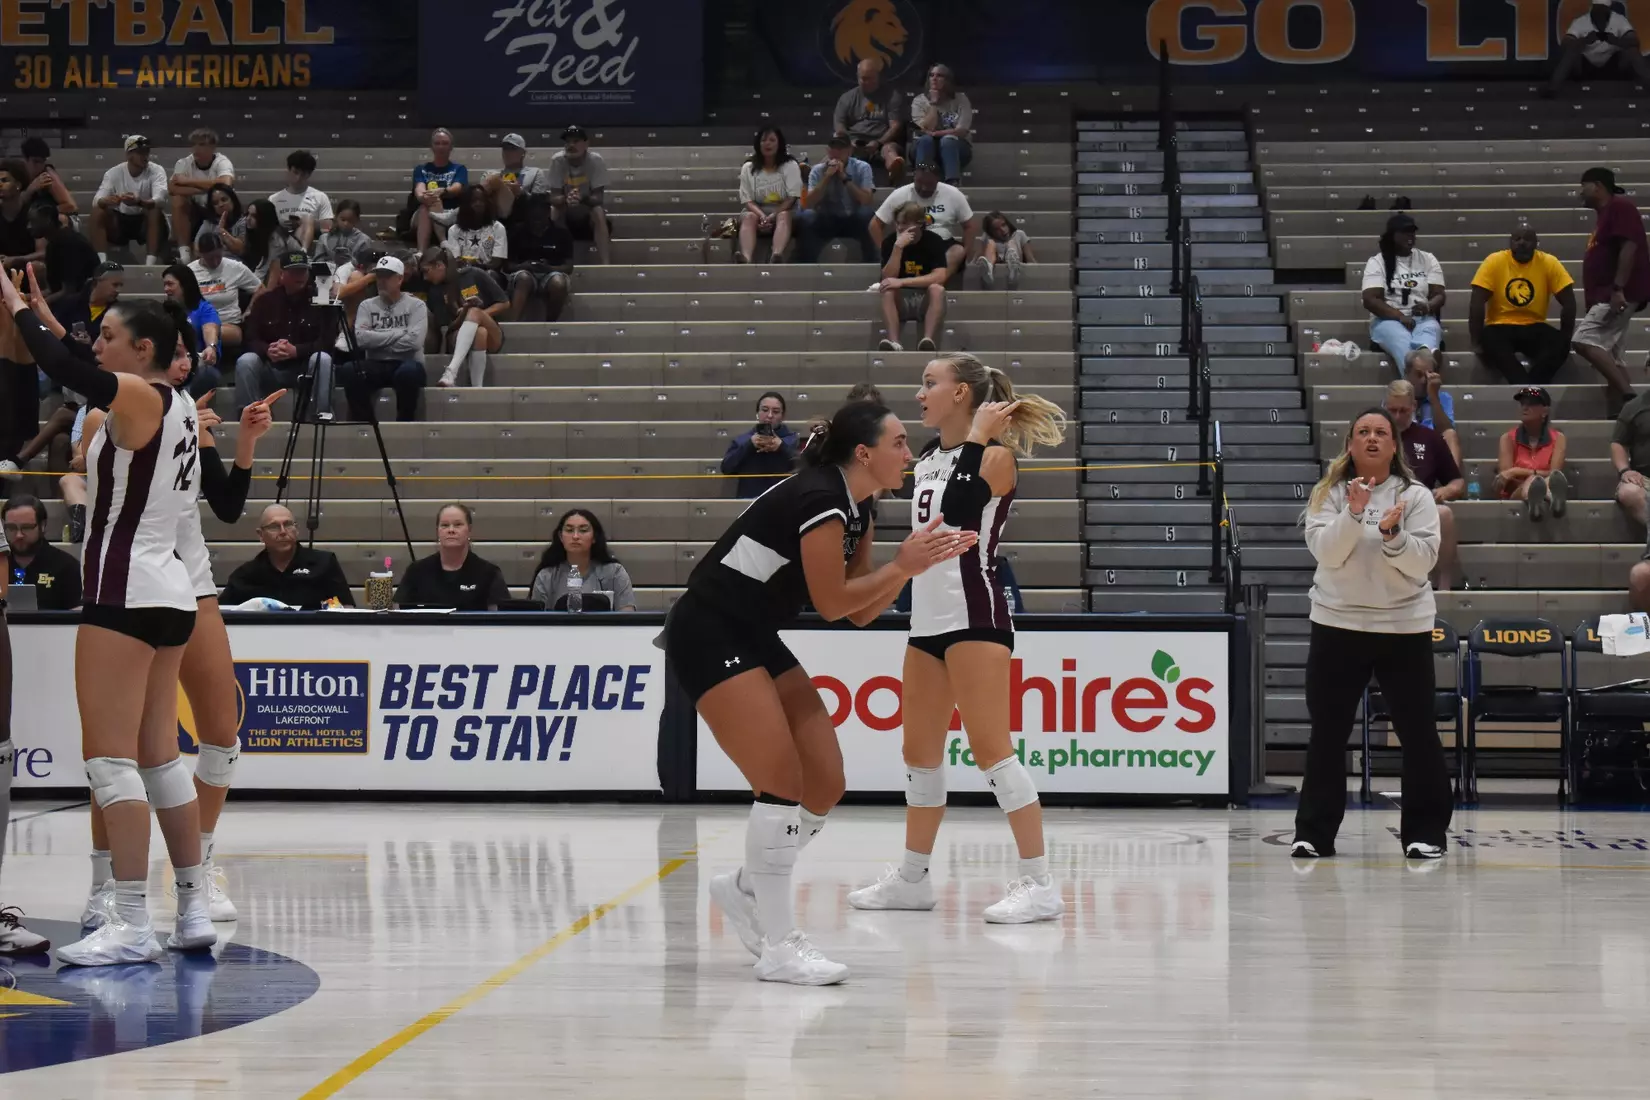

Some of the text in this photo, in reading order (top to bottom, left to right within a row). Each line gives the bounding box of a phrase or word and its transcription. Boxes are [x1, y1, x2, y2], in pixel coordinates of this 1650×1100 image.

[0, 0, 335, 46] ETBALL
[1146, 0, 1356, 66] GO
[505, 33, 639, 97] Feed
[14, 54, 312, 89] 30 ALL-AMERICANS
[1131, 208, 1141, 217] 15
[1131, 233, 1142, 242] 14
[1135, 259, 1147, 269] 13
[1140, 286, 1152, 296] 12
[1157, 344, 1169, 354] 10
[1111, 486, 1119, 497] C
[1176, 486, 1183, 498] 6
[918, 489, 934, 523] 9
[1167, 528, 1174, 540] 5
[1107, 571, 1115, 583] C
[1178, 573, 1186, 585] 4
[1483, 628, 1552, 644] LIONS
[248, 667, 360, 697] Hilton
[379, 664, 651, 711] BEST PLACE
[257, 704, 349, 714] DALLAS/ROCKWALL
[275, 716, 331, 725] LAKEFRONT
[248, 738, 364, 747] LION ATHLETICS
[383, 715, 578, 761] TO STAY!
[1048, 738, 1216, 776] pharmacy
